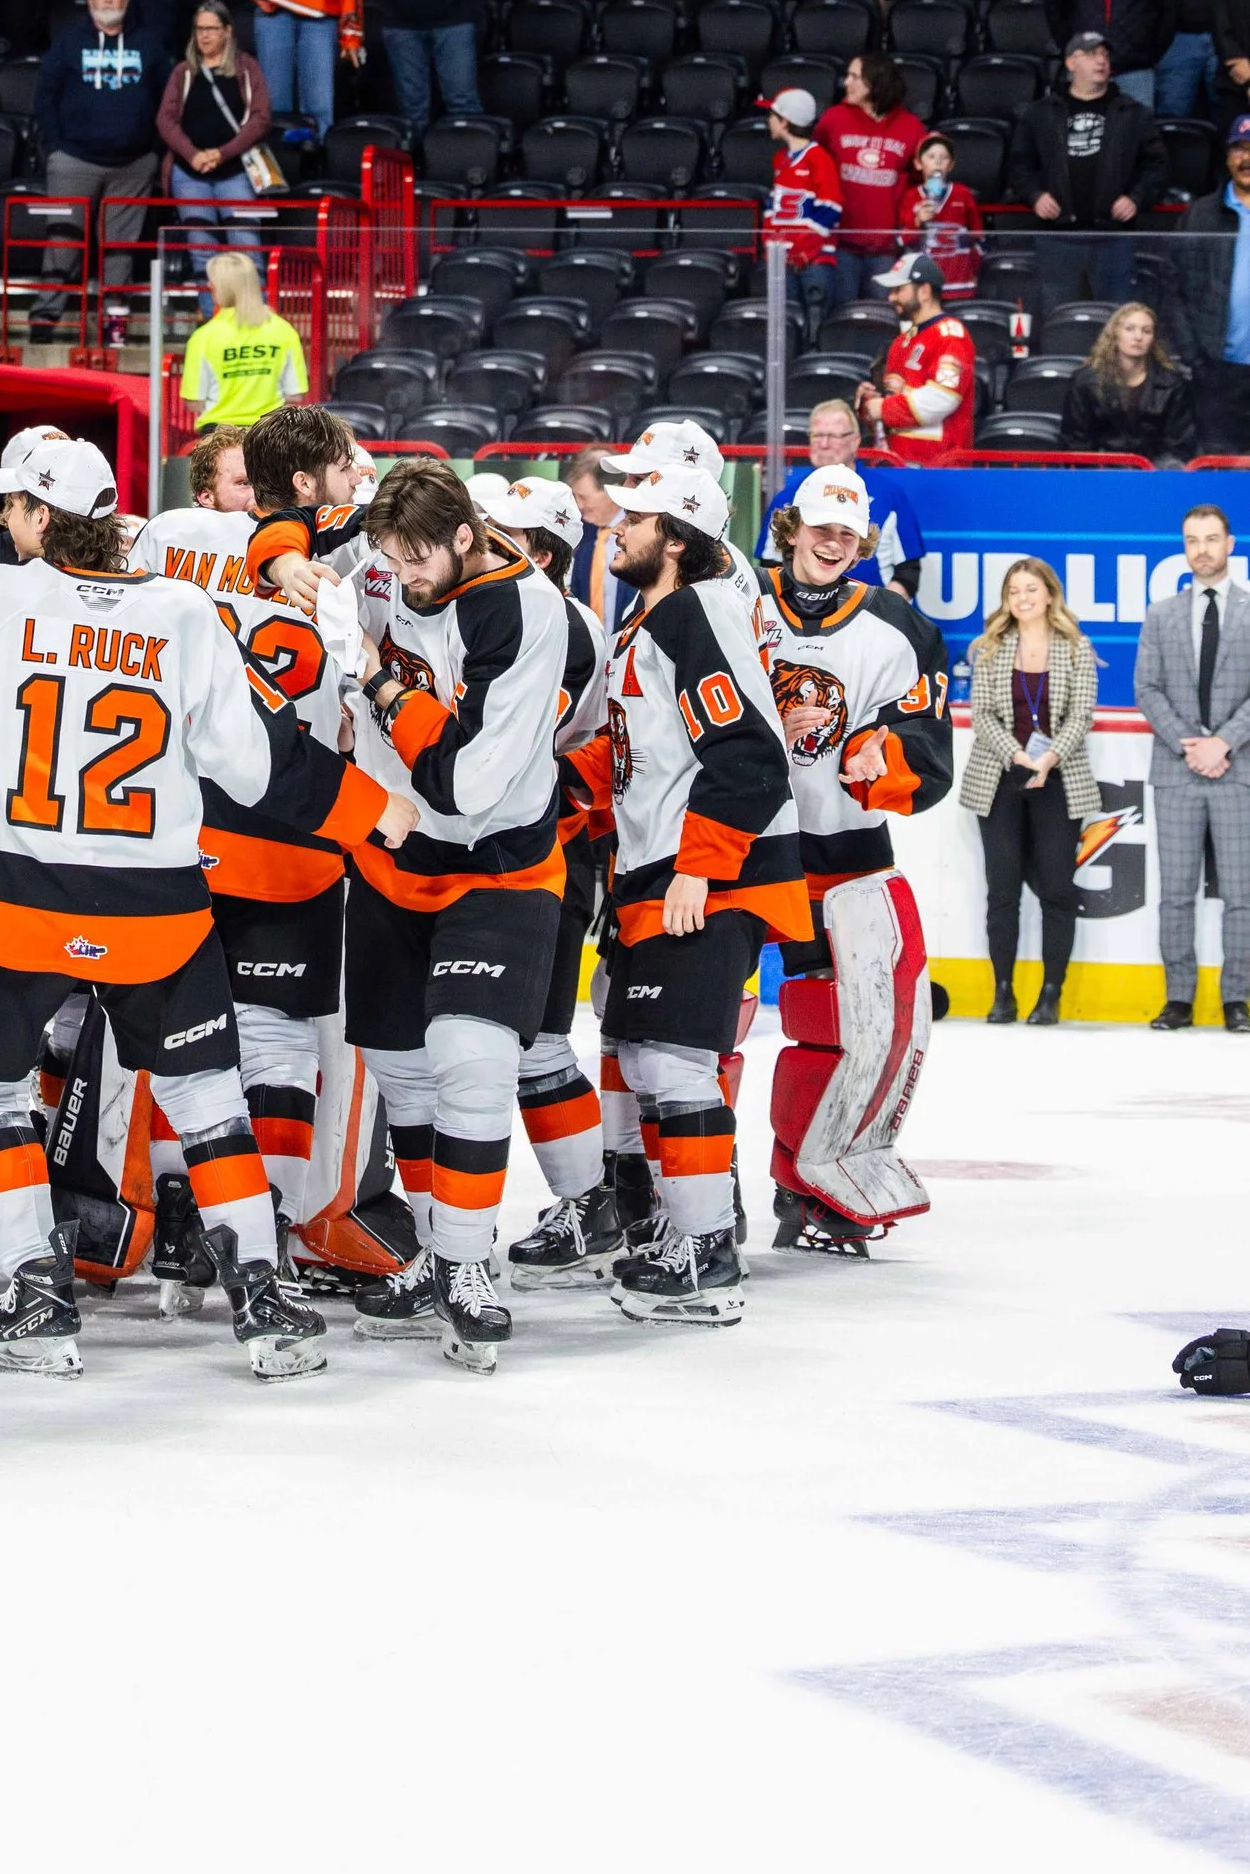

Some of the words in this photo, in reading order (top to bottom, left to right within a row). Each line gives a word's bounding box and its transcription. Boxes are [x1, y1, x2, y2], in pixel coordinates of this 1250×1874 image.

[223, 345, 281, 363] BEST
[165, 546, 217, 585] VAN
[76, 584, 125, 597] CCM
[21, 618, 57, 665] L.
[68, 623, 170, 683] RUCK
[615, 644, 644, 698] A
[678, 671, 746, 744] 10
[5, 672, 172, 839] 12
[236, 961, 307, 977] CCM
[432, 960, 506, 978] CCM
[626, 985, 663, 1000] CM
[163, 1012, 228, 1050] CCM
[891, 1047, 925, 1132] BAUER
[52, 1077, 88, 1168] BAUER
[681, 1262, 711, 1285] BER
[1193, 1373, 1214, 1384] CCM
